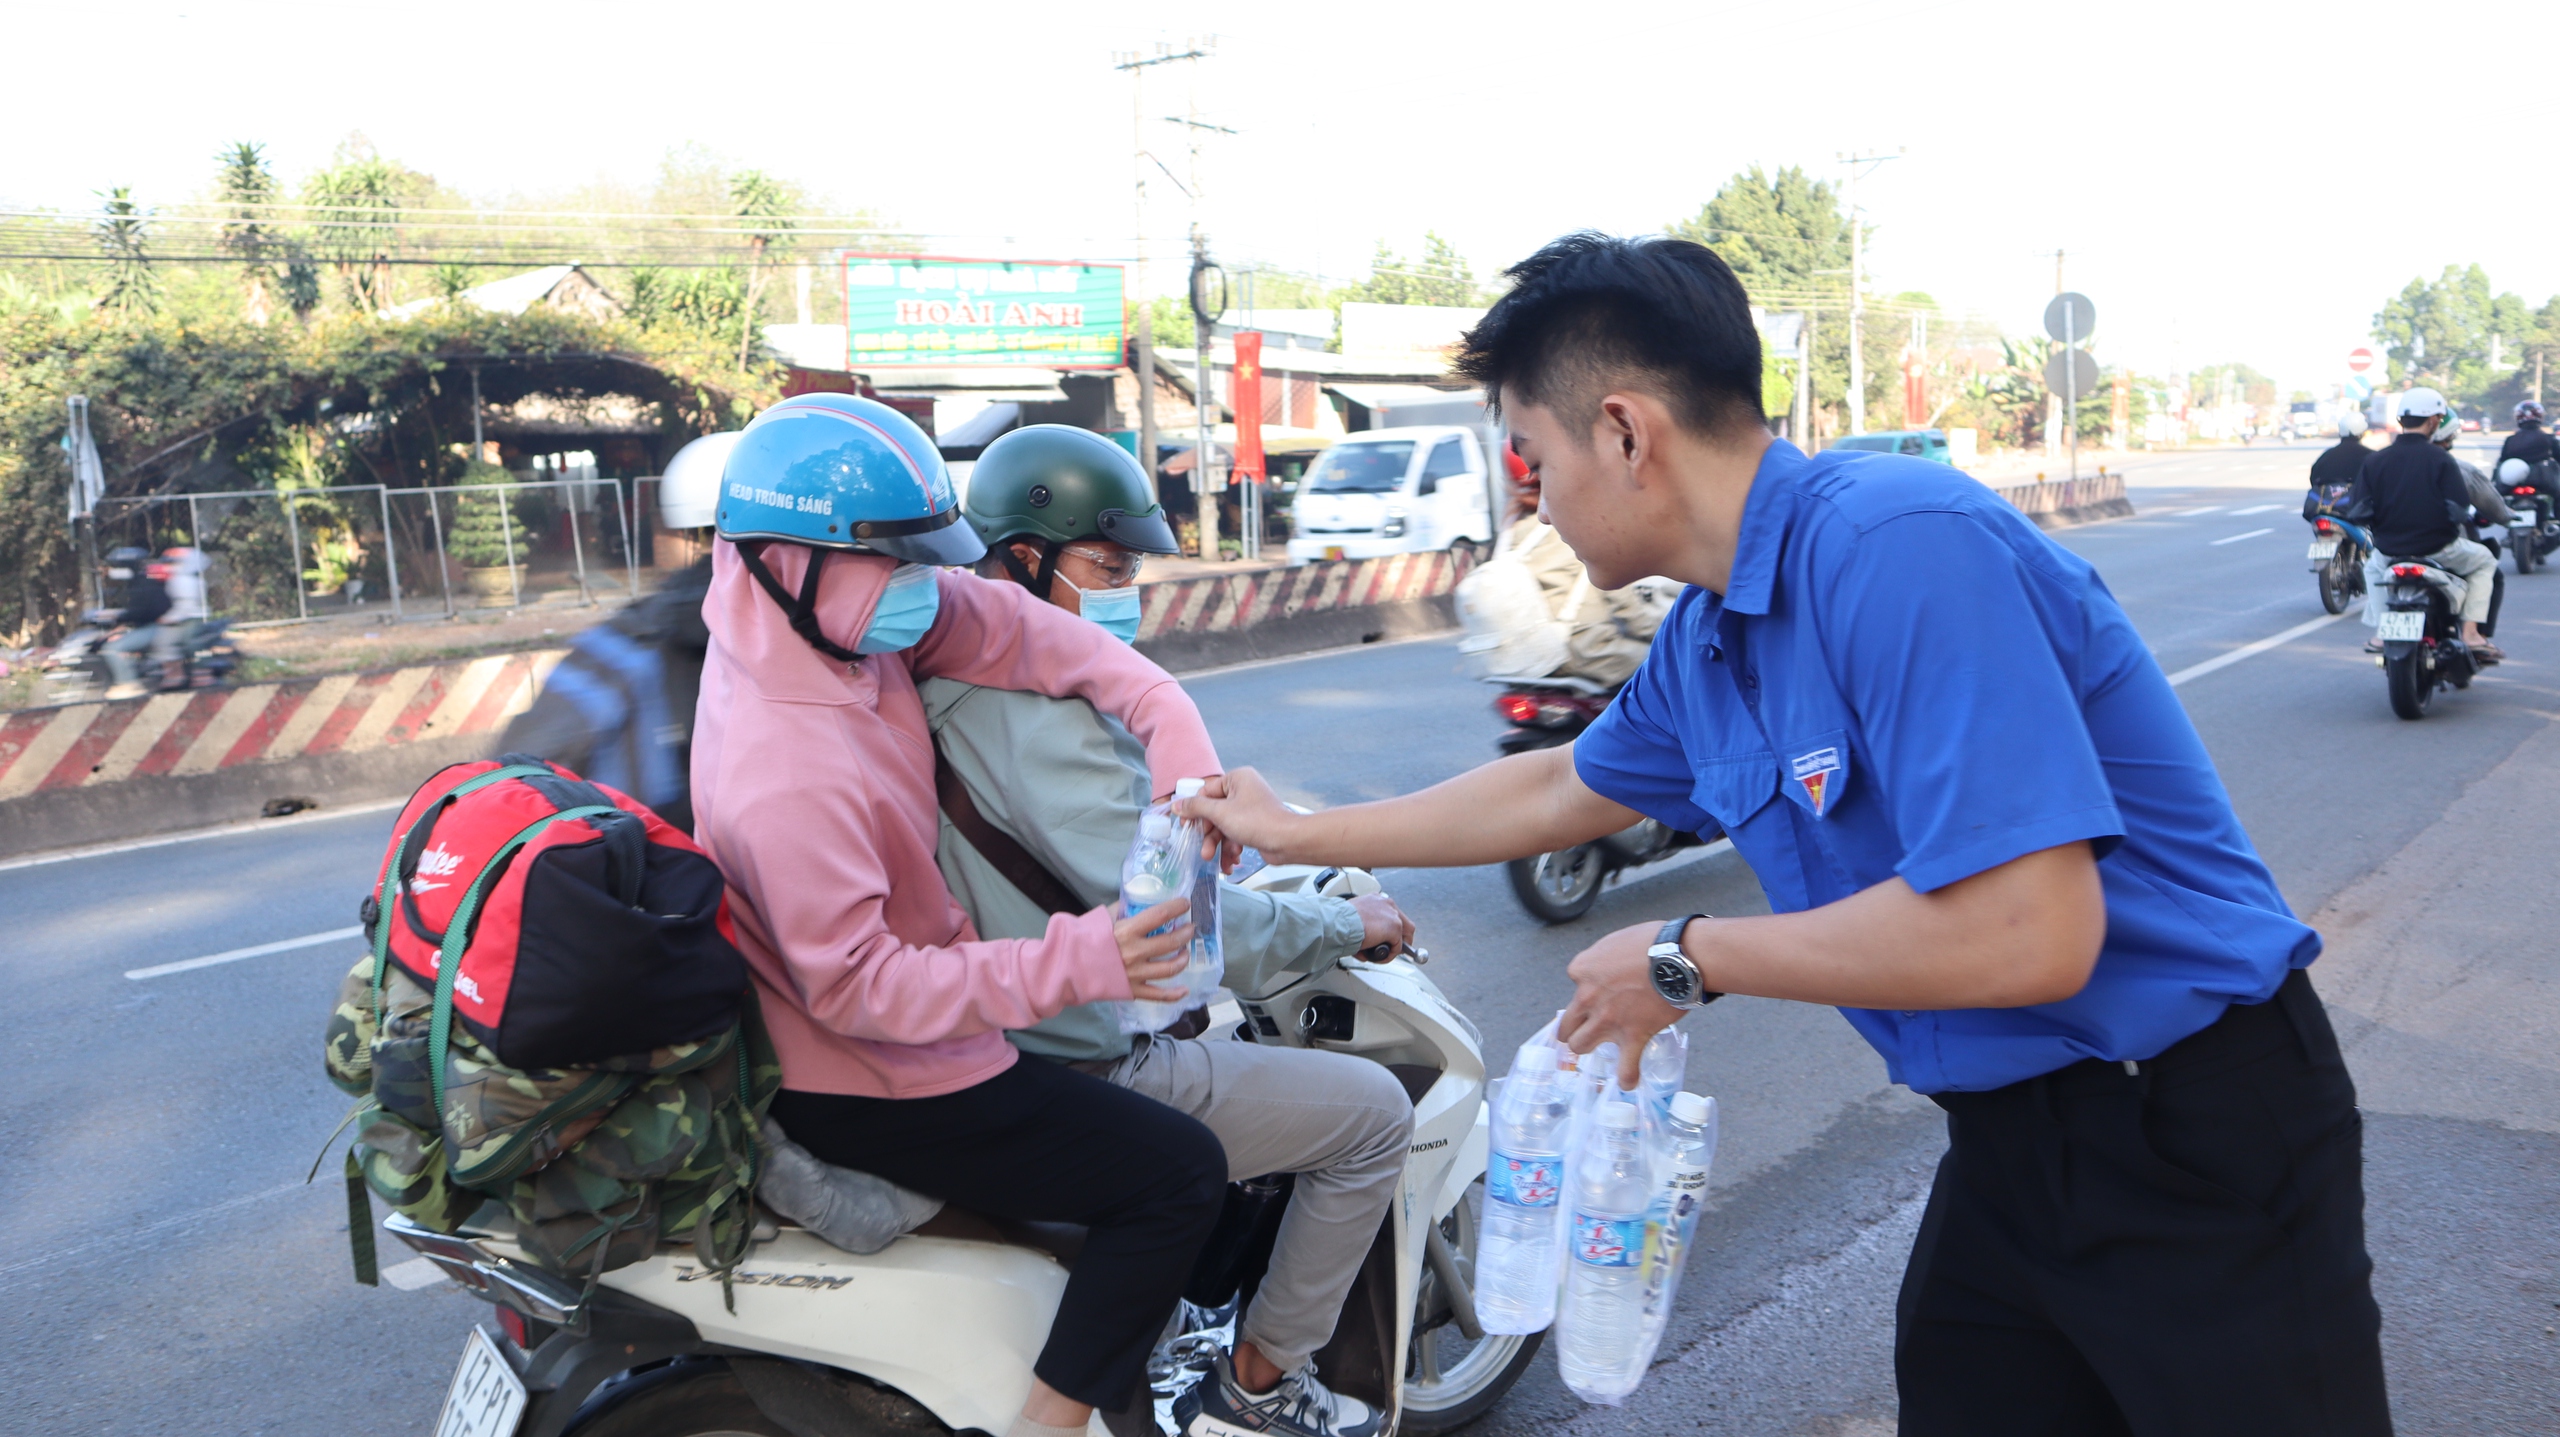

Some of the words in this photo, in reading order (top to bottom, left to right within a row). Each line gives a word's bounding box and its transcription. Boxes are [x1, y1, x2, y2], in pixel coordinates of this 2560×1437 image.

[898, 291, 994, 326] HOÀI
[1002, 301, 1084, 327] ANH
[729, 482, 753, 501] HEAD
[755, 488, 795, 511] TRONG
[796, 494, 833, 516] SÁNG
[1410, 1138, 1448, 1154] HONDA
